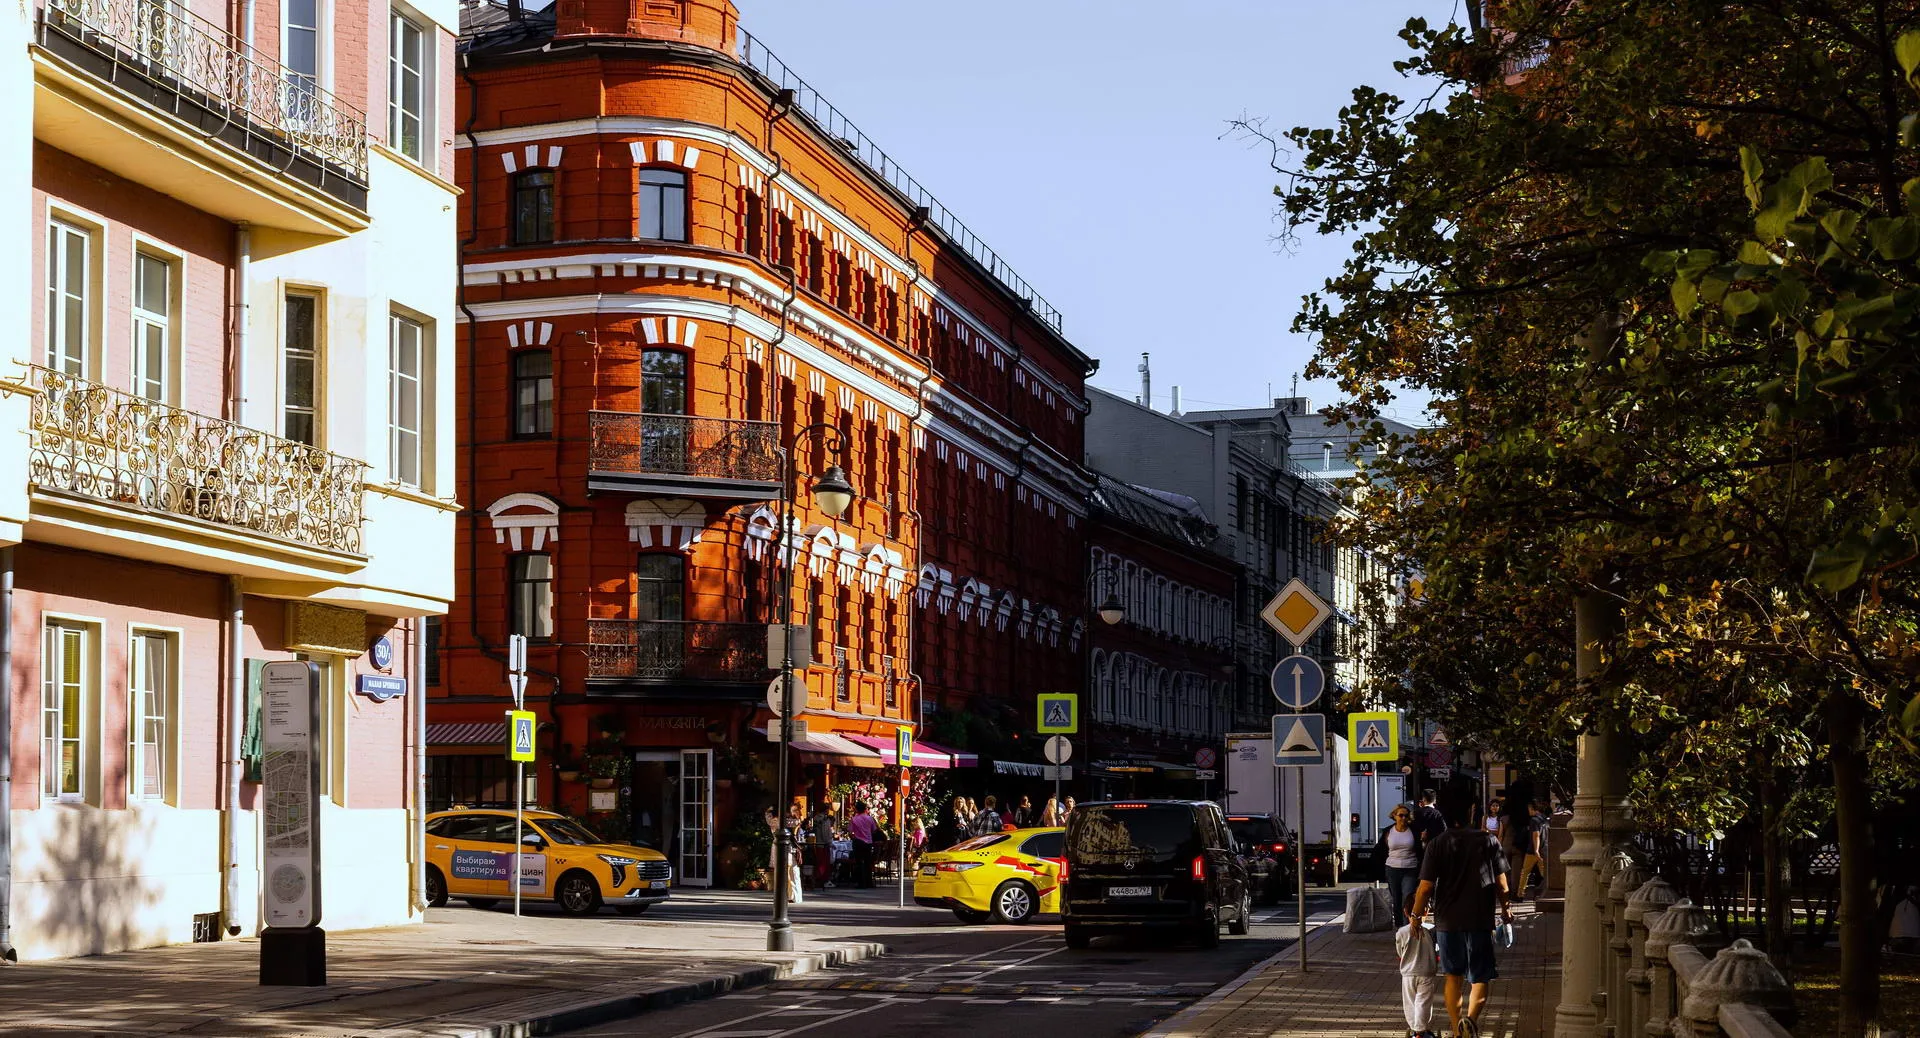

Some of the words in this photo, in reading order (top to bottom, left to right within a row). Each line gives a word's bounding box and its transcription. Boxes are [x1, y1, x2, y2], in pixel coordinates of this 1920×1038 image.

[456, 856, 496, 866] Выбираю
[456, 866, 495, 876] квартиру
[496, 867, 507, 875] на
[521, 868, 544, 877] циан
